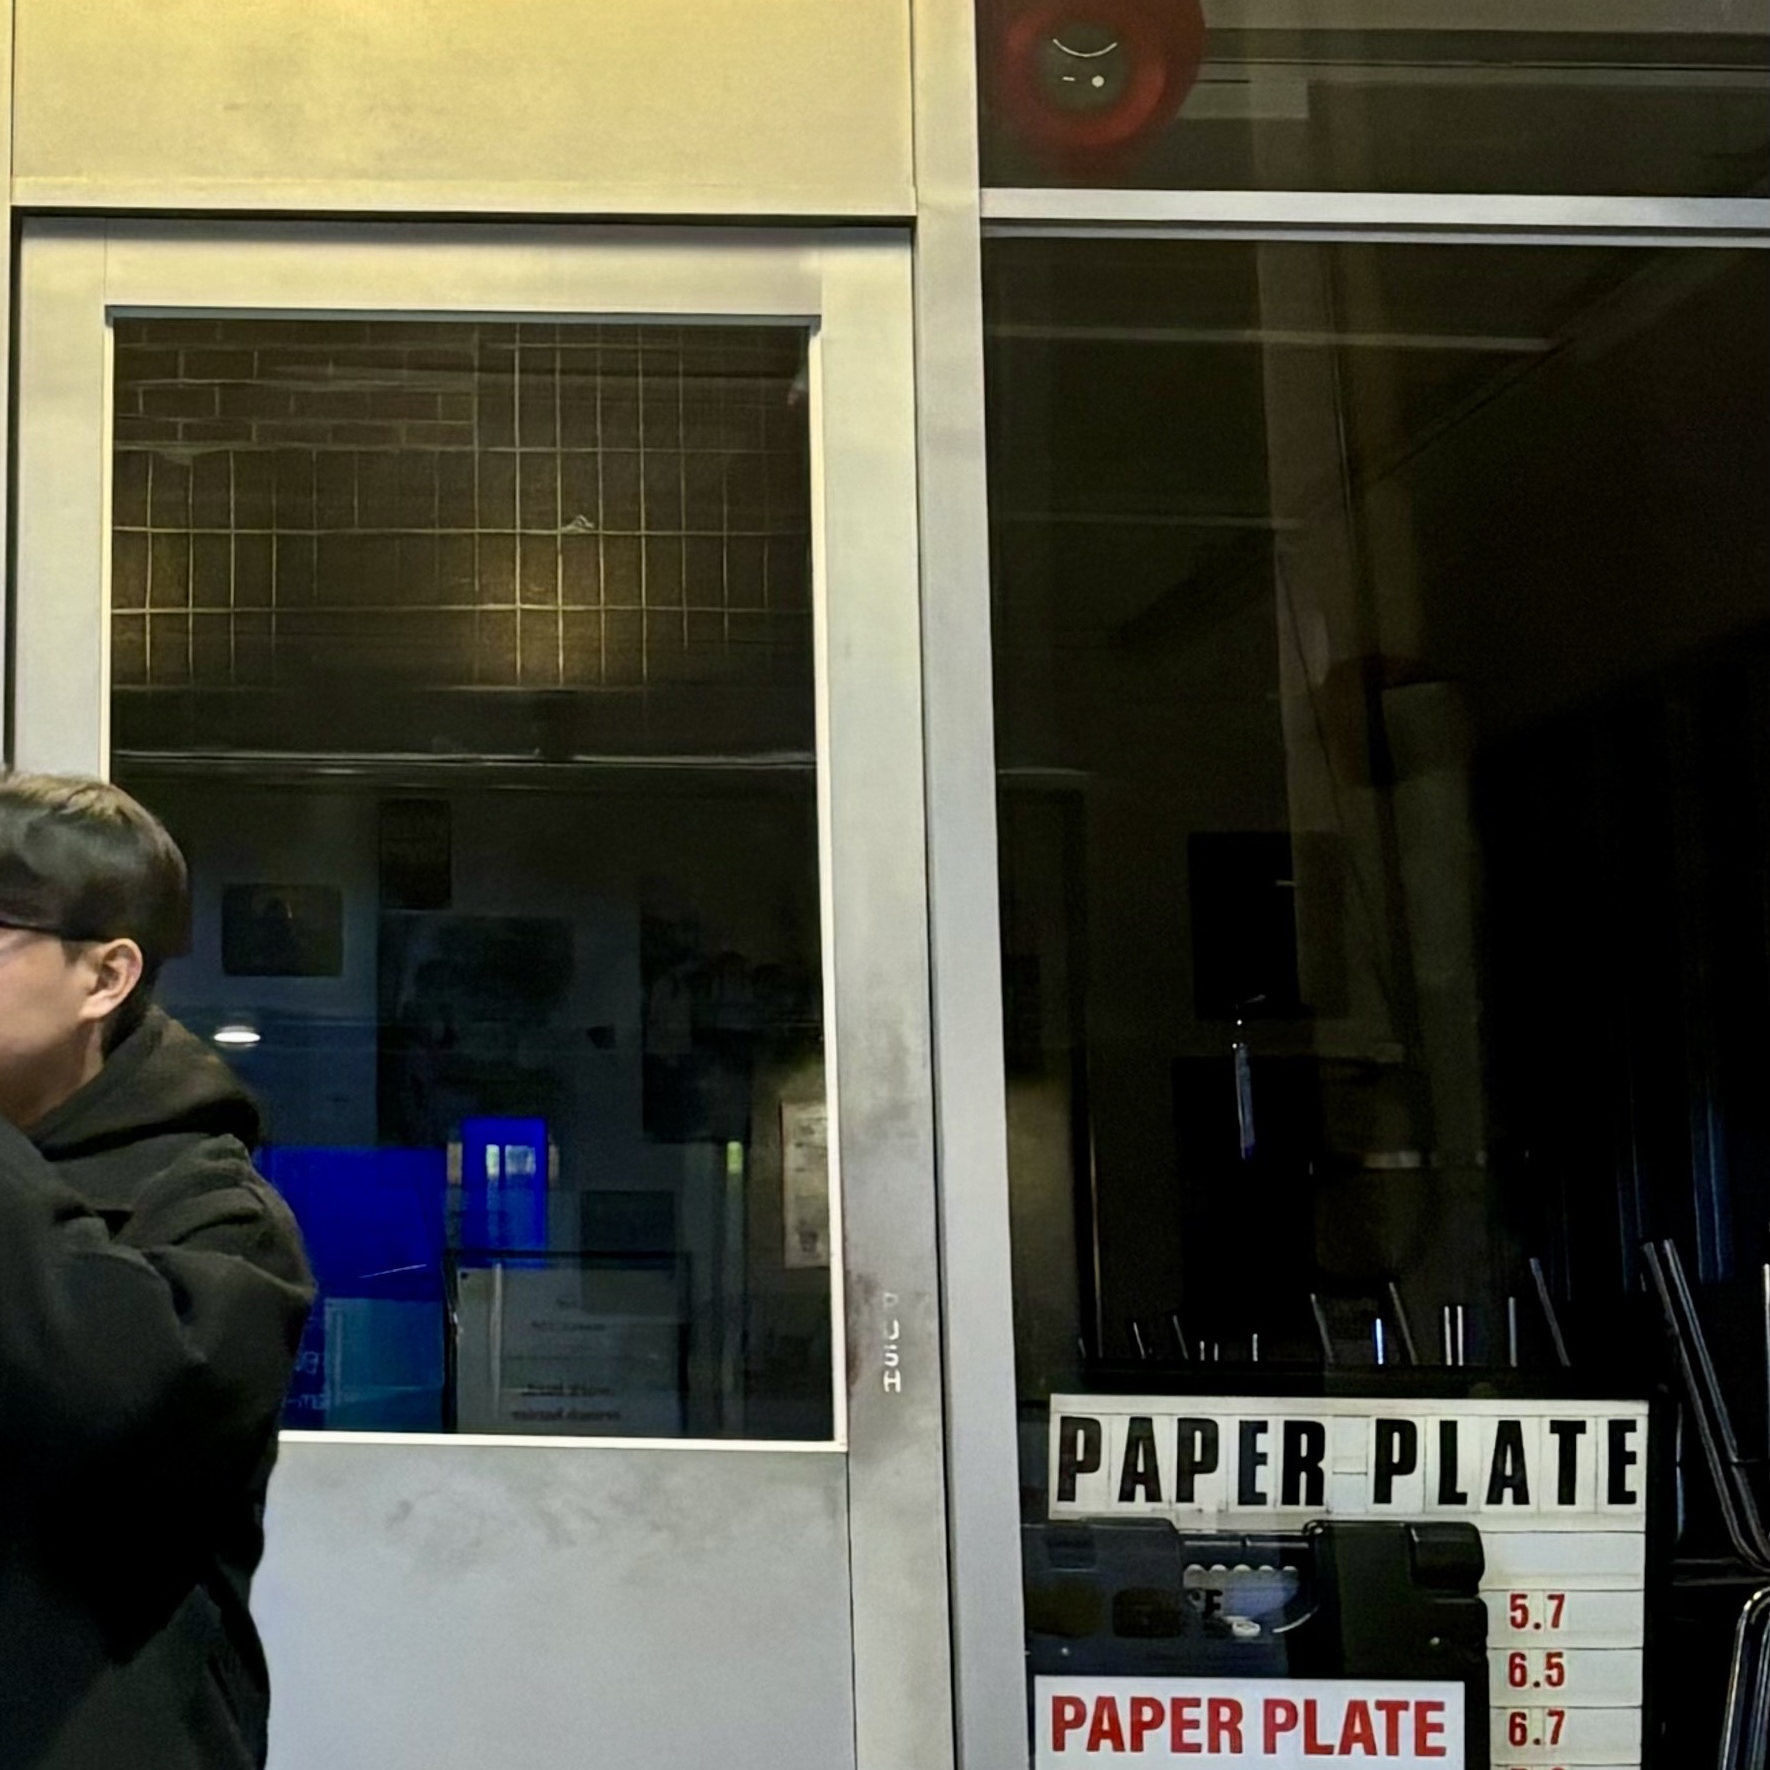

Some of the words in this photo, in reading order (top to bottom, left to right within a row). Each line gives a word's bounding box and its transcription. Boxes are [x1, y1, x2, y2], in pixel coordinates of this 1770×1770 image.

[1056, 1415, 1326, 1508] PAPER
[1373, 1418, 1638, 1508] PLATE
[1509, 1593, 1566, 1630] 5.7
[1508, 1651, 1566, 1688] 6.5
[1051, 1695, 1243, 1755] PAPER
[1263, 1698, 1448, 1758] PLATE
[1508, 1709, 1566, 1747] 6.7
